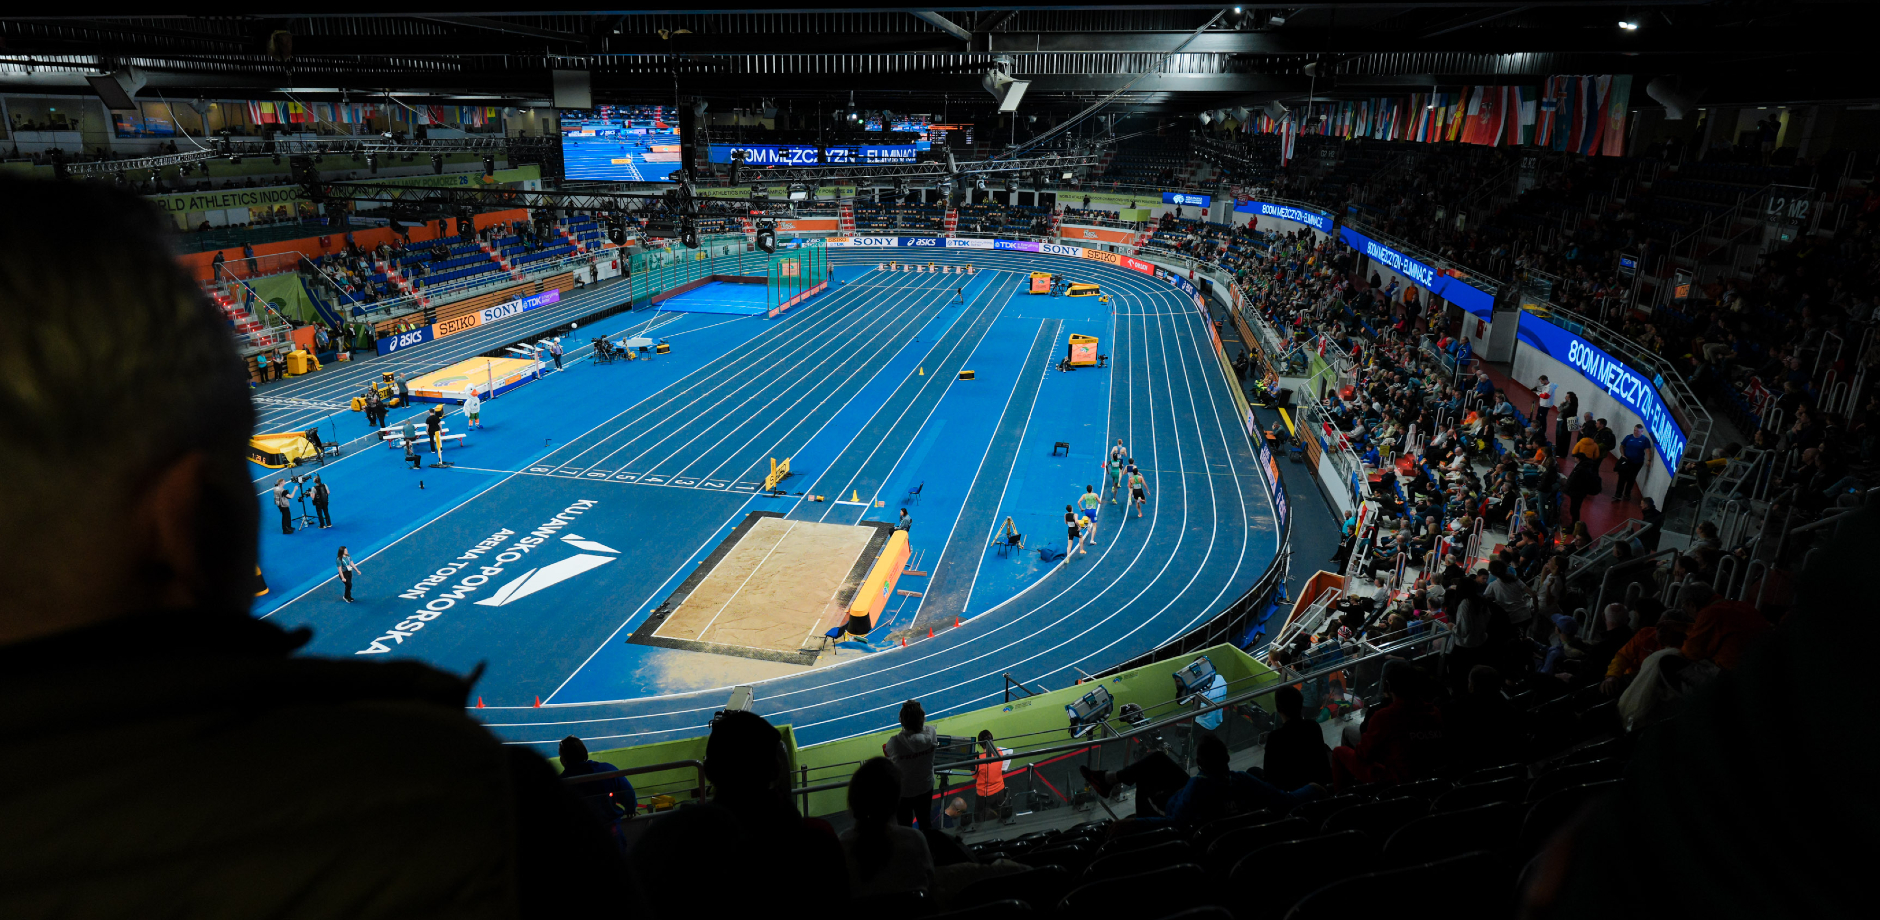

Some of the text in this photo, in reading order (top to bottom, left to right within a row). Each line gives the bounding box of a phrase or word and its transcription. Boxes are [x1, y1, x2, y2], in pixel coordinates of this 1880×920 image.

[189, 192, 258, 210] ATHLETICS
[422, 176, 458, 187] POMORZE
[458, 175, 468, 185] 26
[1767, 196, 1809, 220] L2 M2
[853, 237, 894, 246] SONY
[915, 238, 936, 246] asics
[953, 239, 970, 247] TDK
[1000, 241, 1017, 249] TDK
[1043, 244, 1079, 256] SONY
[1087, 250, 1117, 263] SEIKO
[1367, 241, 1379, 261] 800M
[1376, 246, 1402, 269] MĘŻCZYZN
[1402, 258, 1434, 287] ELIMINACJE
[1134, 261, 1148, 271] ORLEN
[527, 296, 542, 308] TDK
[484, 302, 519, 322] SONY
[439, 314, 476, 335] SEIKO
[399, 330, 422, 347] asics
[1568, 339, 1600, 377] 800M
[1597, 357, 1654, 421] MĘŻCZYZN
[398, 528, 515, 600] ARENA TORUŃ
[355, 500, 598, 655] KUJAWSKO-POMORSKA
